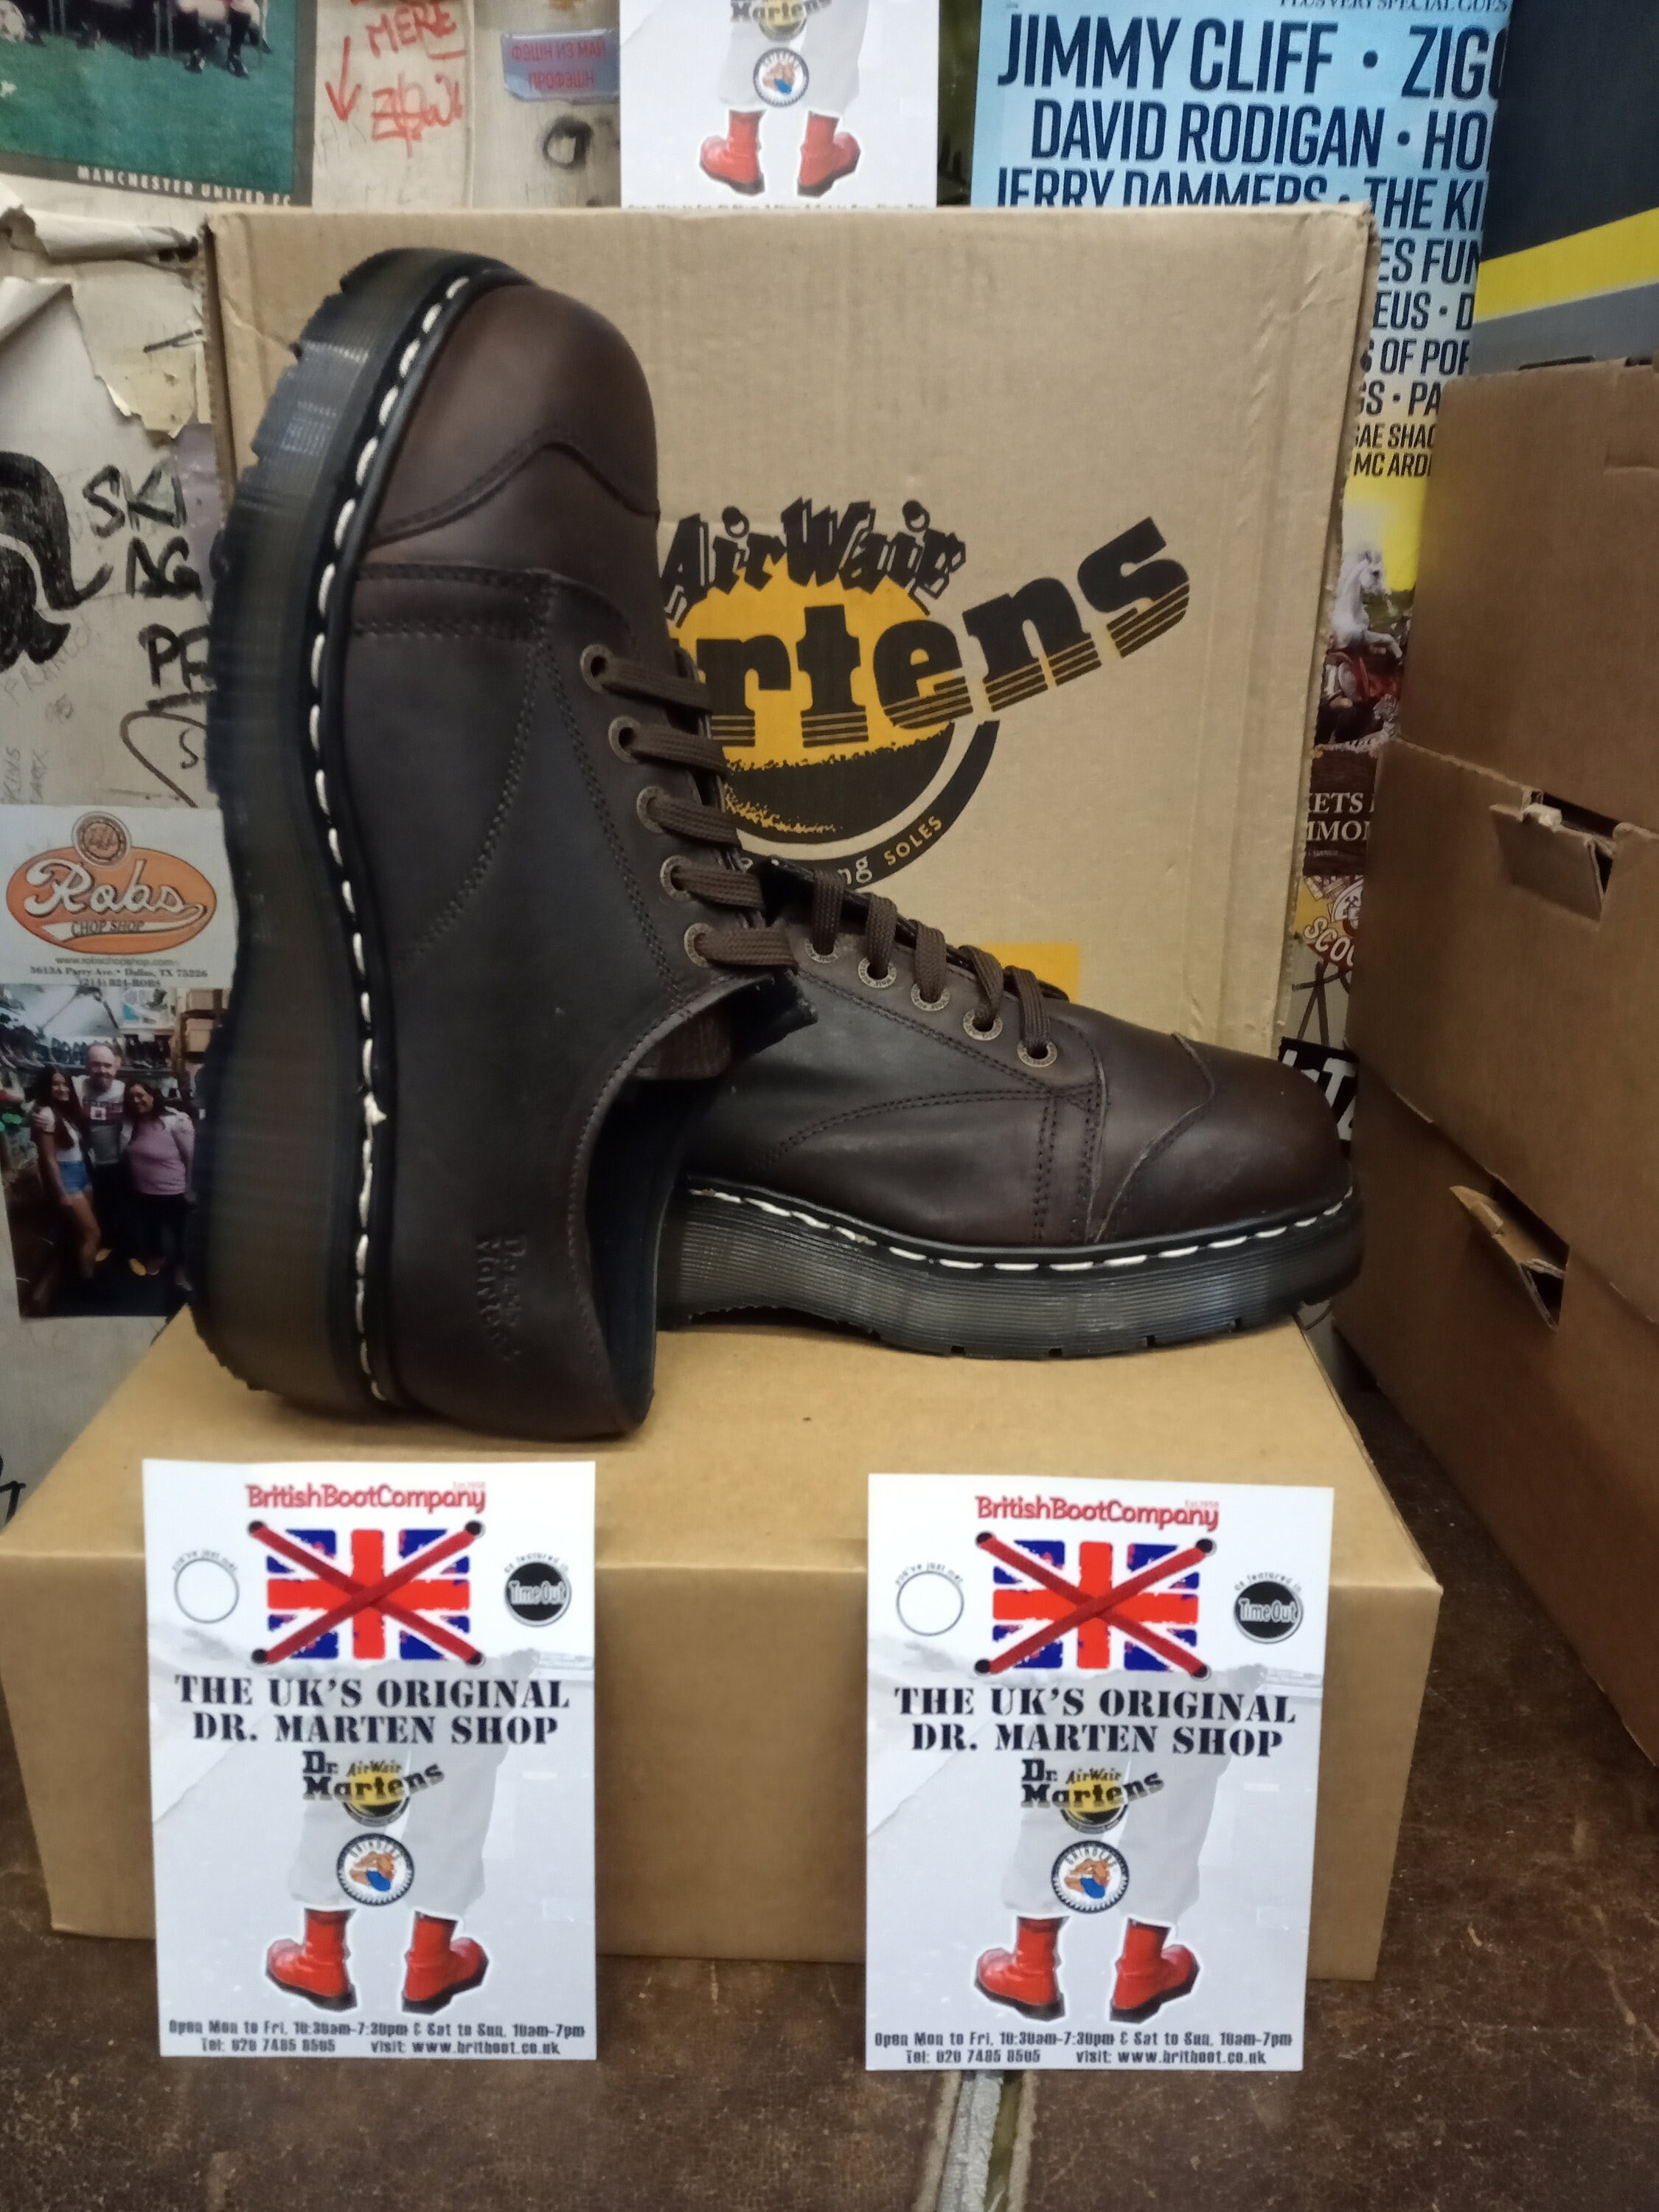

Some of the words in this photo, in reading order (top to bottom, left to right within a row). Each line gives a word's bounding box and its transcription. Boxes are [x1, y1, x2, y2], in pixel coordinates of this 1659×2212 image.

[998, 13, 1182, 91] JIMMY
[1189, 16, 1338, 94] CLIFF
[1032, 99, 1168, 161] DAVID
[1178, 102, 1385, 168] RODIGAN
[1422, 108, 1490, 173] HO
[77, 164, 194, 196] MANCHESTER
[201, 183, 265, 206] UNITED
[1364, 176, 1439, 229] THE
[1443, 178, 1485, 232] KI
[1377, 235, 1416, 284] ES
[1373, 290, 1431, 331] EUS
[1380, 337, 1417, 375] OF
[1353, 452, 1385, 477] MC
[1386, 452, 1433, 478] ARD
[666, 516, 1191, 748] rtens
[1310, 792, 1364, 814] ETS
[884, 815, 943, 867] SOLES
[71, 921, 107, 937] CHOP
[111, 921, 145, 933] SHOP
[245, 1481, 487, 1515] BritishBootCompany
[975, 1495, 1220, 1532] BritishBootCompany
[174, 1674, 254, 1706] THE
[377, 1678, 570, 1709] ORIGINAL
[894, 1686, 975, 1716] THE
[1099, 1688, 1296, 1724] ORIGINAL
[192, 1711, 258, 1742] DR.
[274, 1712, 435, 1745] MARTEN
[451, 1715, 559, 1745] SHOP
[911, 1722, 978, 1751] DR.
[996, 1723, 1158, 1753] MARTEN
[1172, 1726, 1284, 1758] SHOP
[302, 1763, 445, 1801] Martens
[1021, 1772, 1165, 1808] Martens
[169, 2019, 203, 2036] Open
[209, 2020, 238, 2035] Mon
[244, 2020, 259, 2035] to
[427, 2023, 452, 2037] Sat
[457, 2023, 472, 2037] to
[874, 2031, 908, 2049] Open
[914, 2032, 944, 2046] Mon
[950, 2032, 964, 2046] to
[1133, 2031, 1158, 2046] Sat
[1164, 2031, 1180, 2046] to
